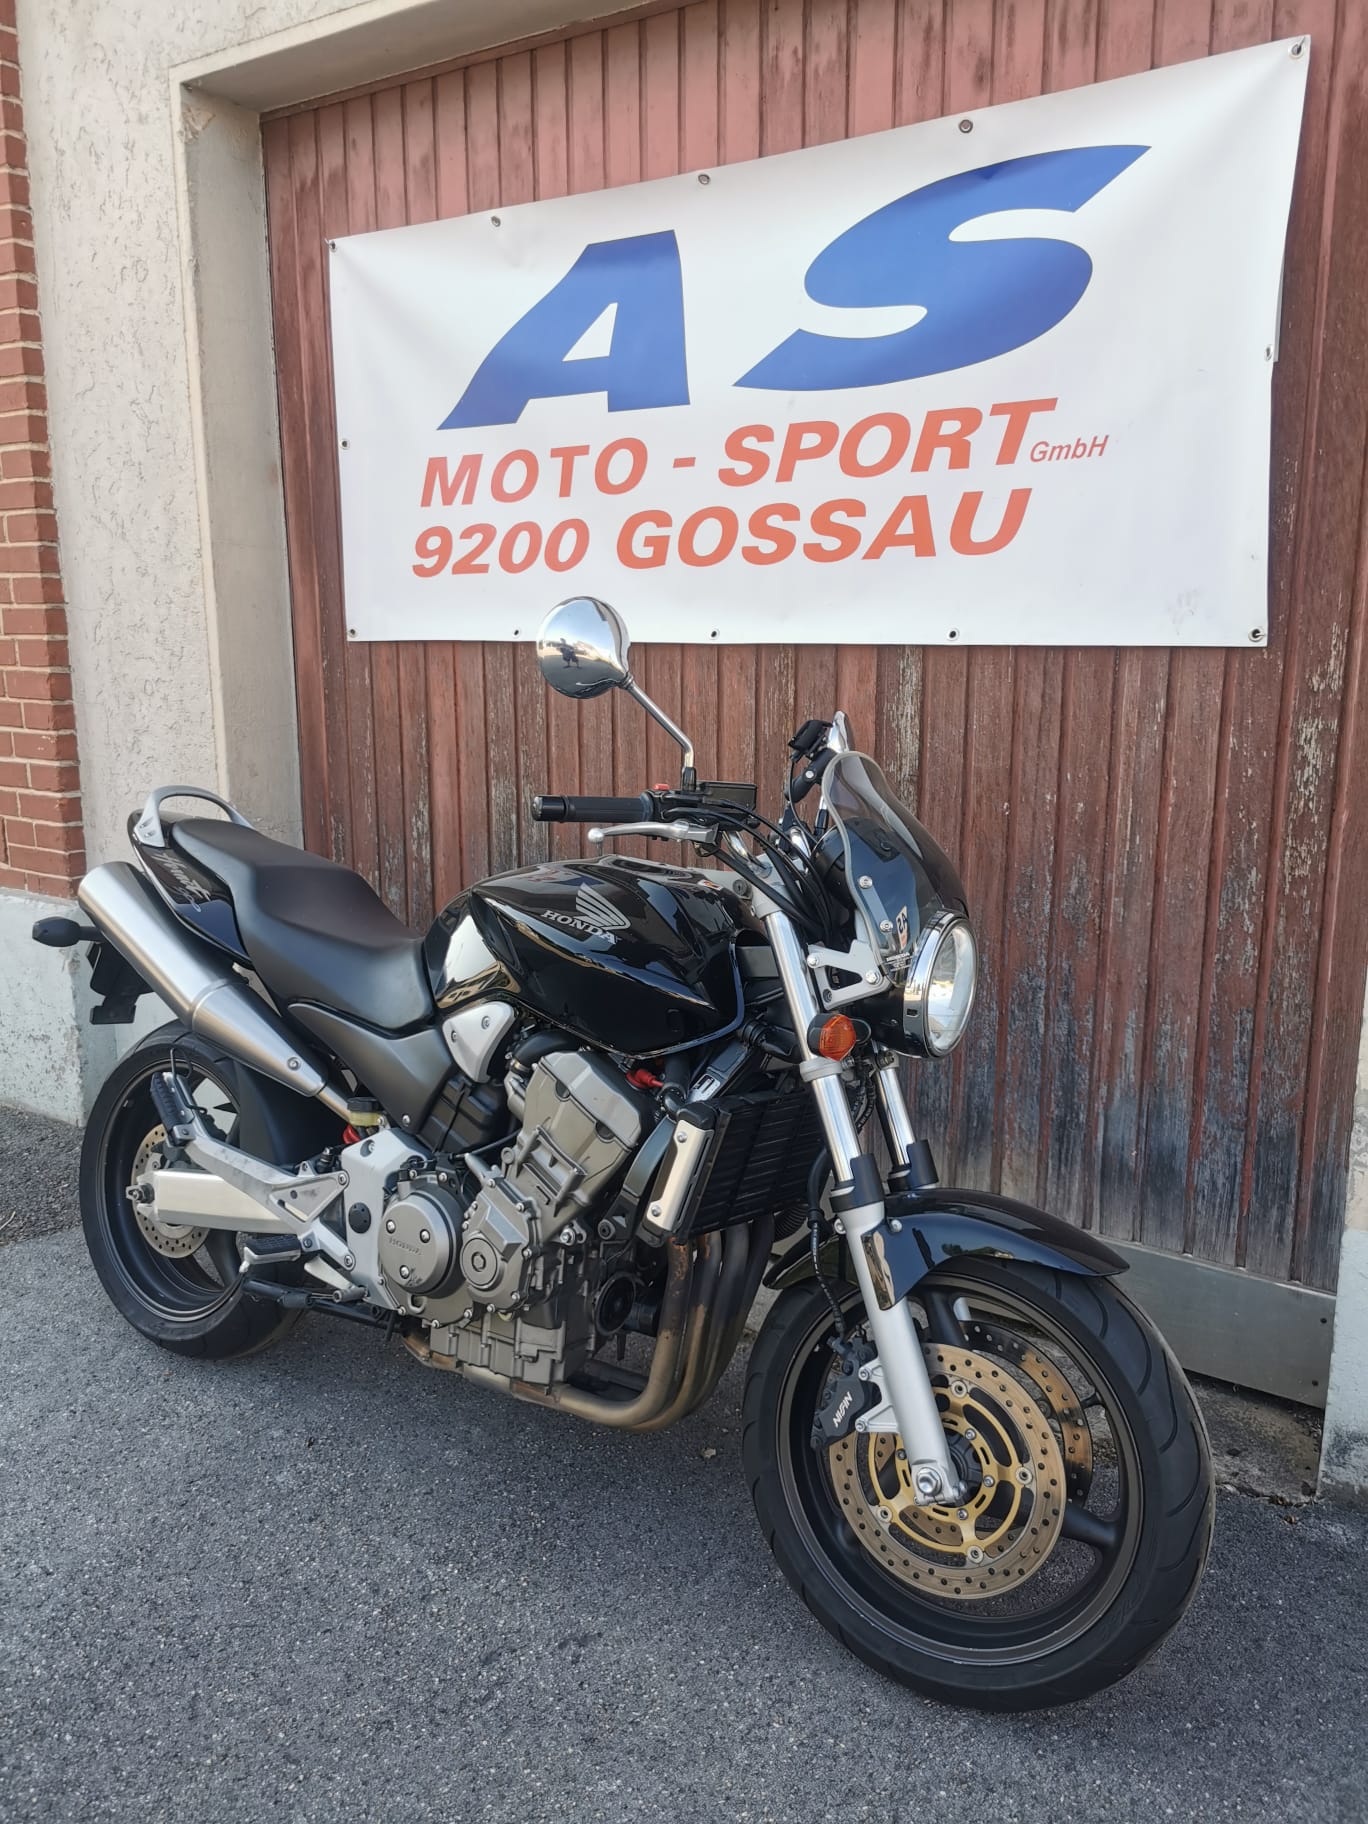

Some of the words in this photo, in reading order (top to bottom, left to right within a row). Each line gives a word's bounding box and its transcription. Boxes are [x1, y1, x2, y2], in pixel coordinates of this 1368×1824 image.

[420, 437, 648, 508] MOTO
[717, 398, 1058, 487] SPORT
[1029, 434, 1110, 463] GmbH
[411, 517, 590, 578] 9200
[615, 488, 1033, 569] GOSSAU
[540, 910, 618, 945] HONDA
